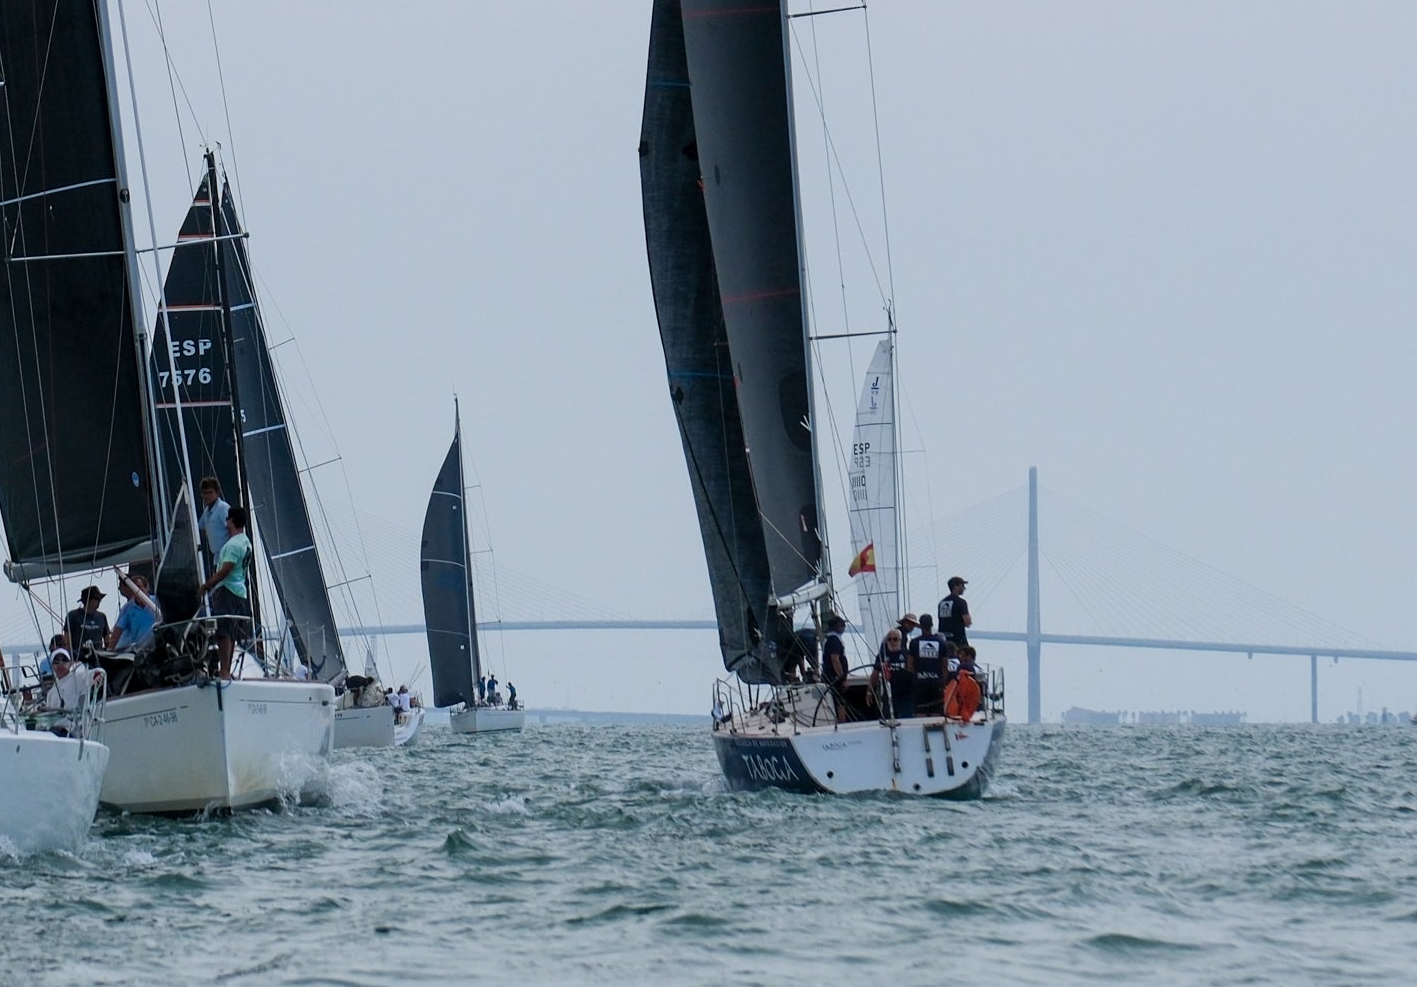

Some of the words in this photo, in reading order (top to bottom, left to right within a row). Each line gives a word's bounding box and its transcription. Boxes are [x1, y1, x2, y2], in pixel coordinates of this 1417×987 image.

[170, 339, 212, 358] ESP
[159, 367, 212, 388] 7576
[853, 442, 871, 455] ESP
